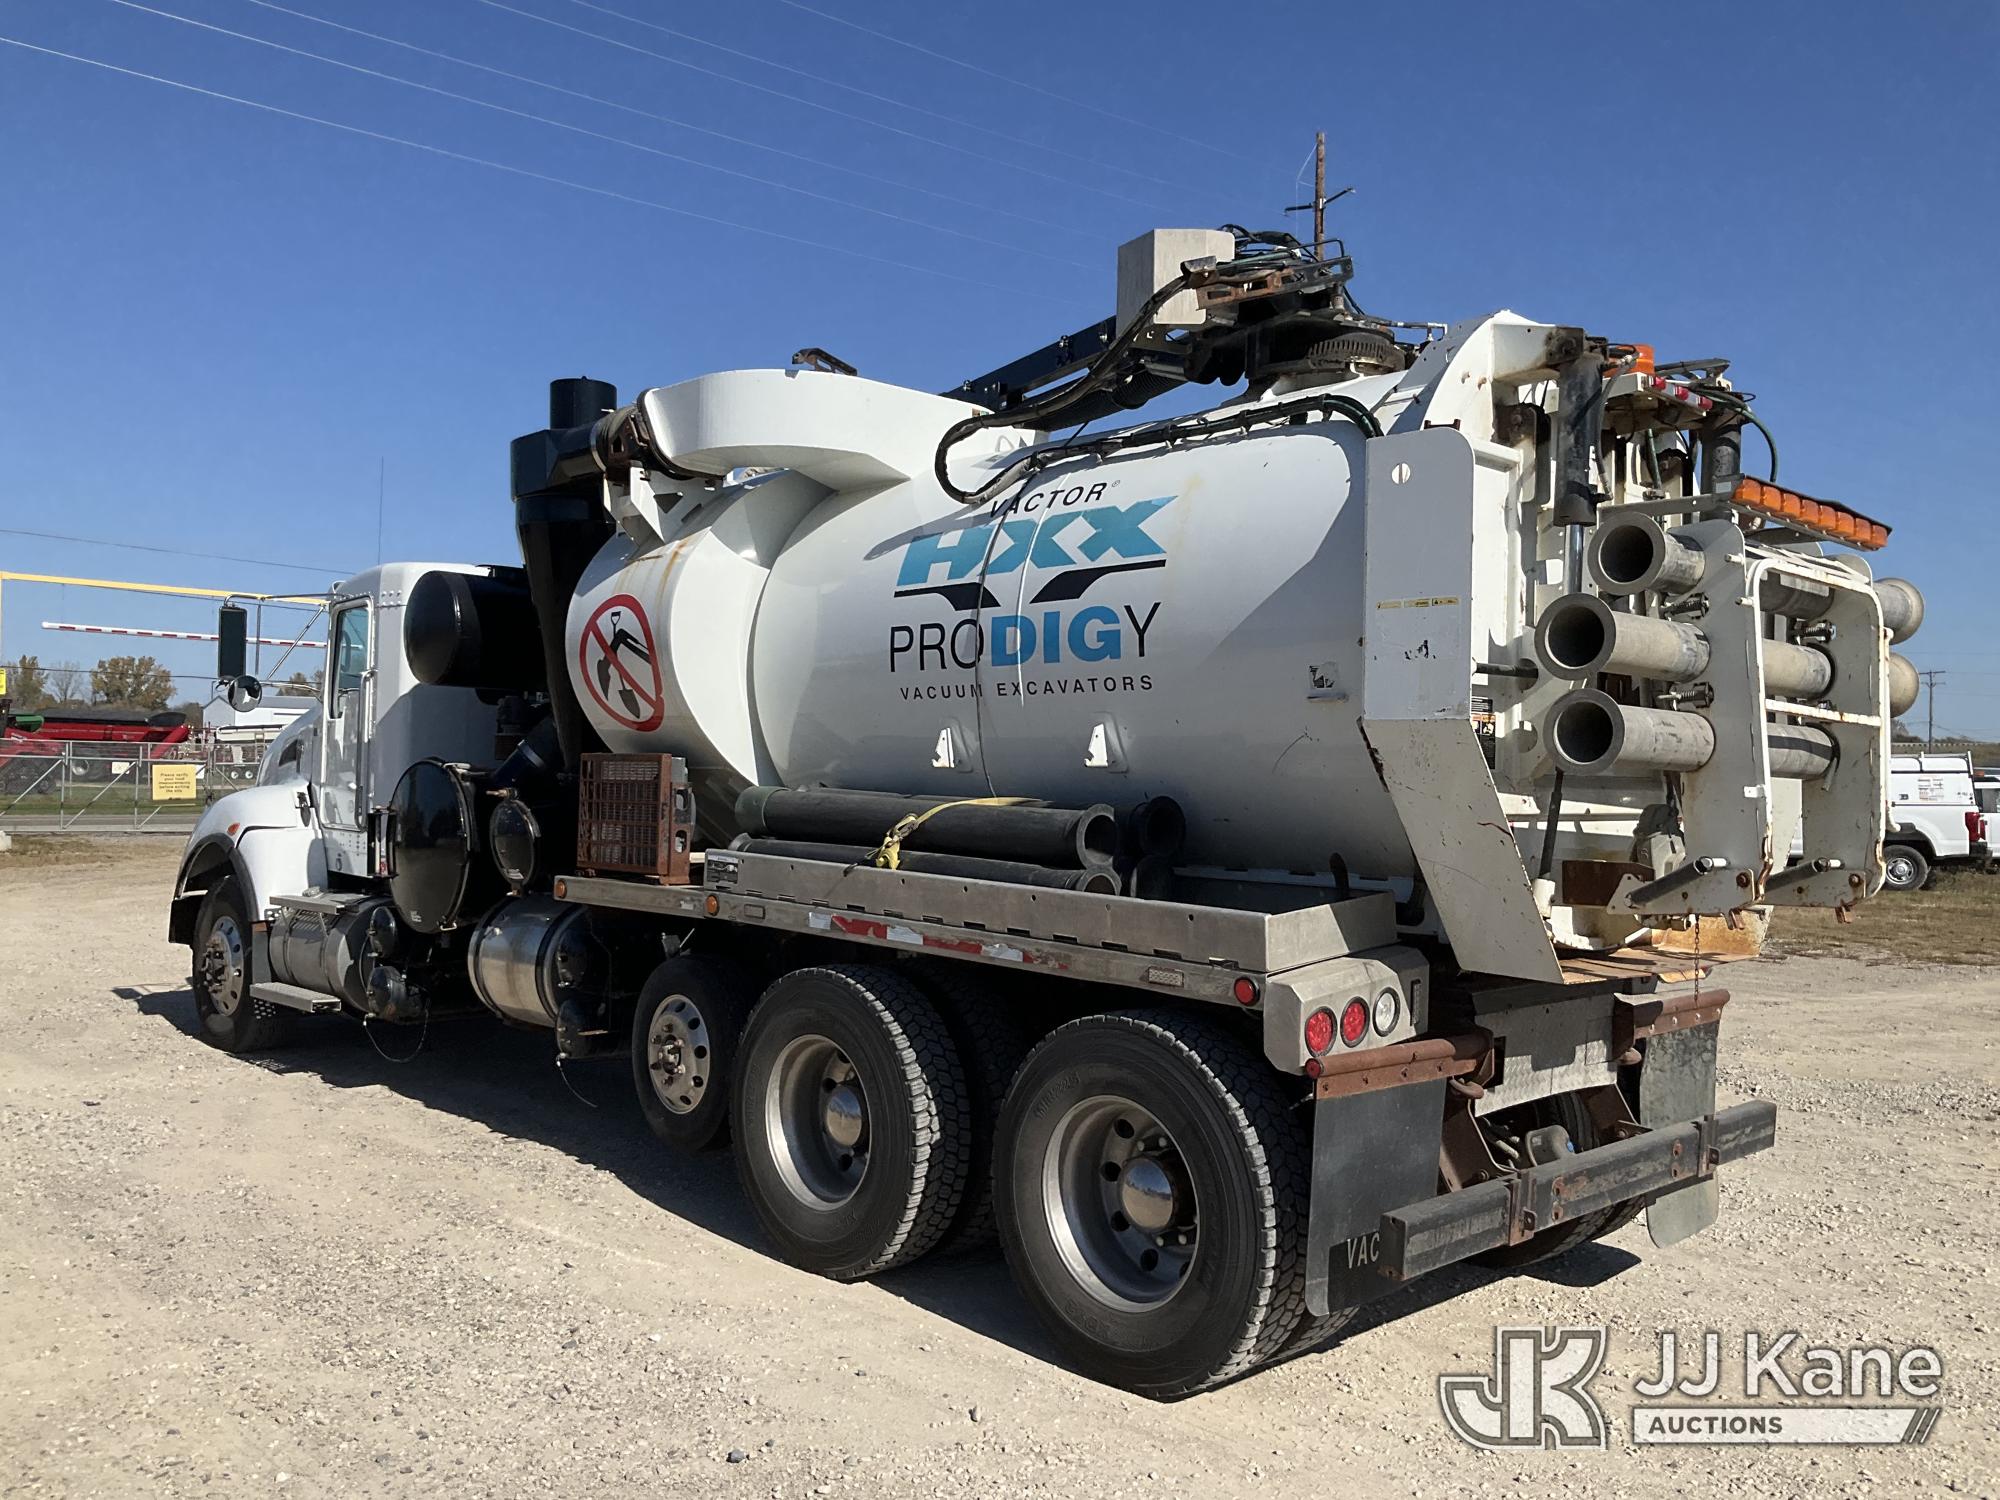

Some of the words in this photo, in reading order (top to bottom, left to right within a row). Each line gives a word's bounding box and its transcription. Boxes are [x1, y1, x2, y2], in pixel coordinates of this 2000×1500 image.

[890, 602, 1162, 673] PRODIGY
[900, 684, 983, 700] VACUUM
[997, 675, 1153, 697] EXCAVATORS
[1347, 1232, 1380, 1269] VAC
